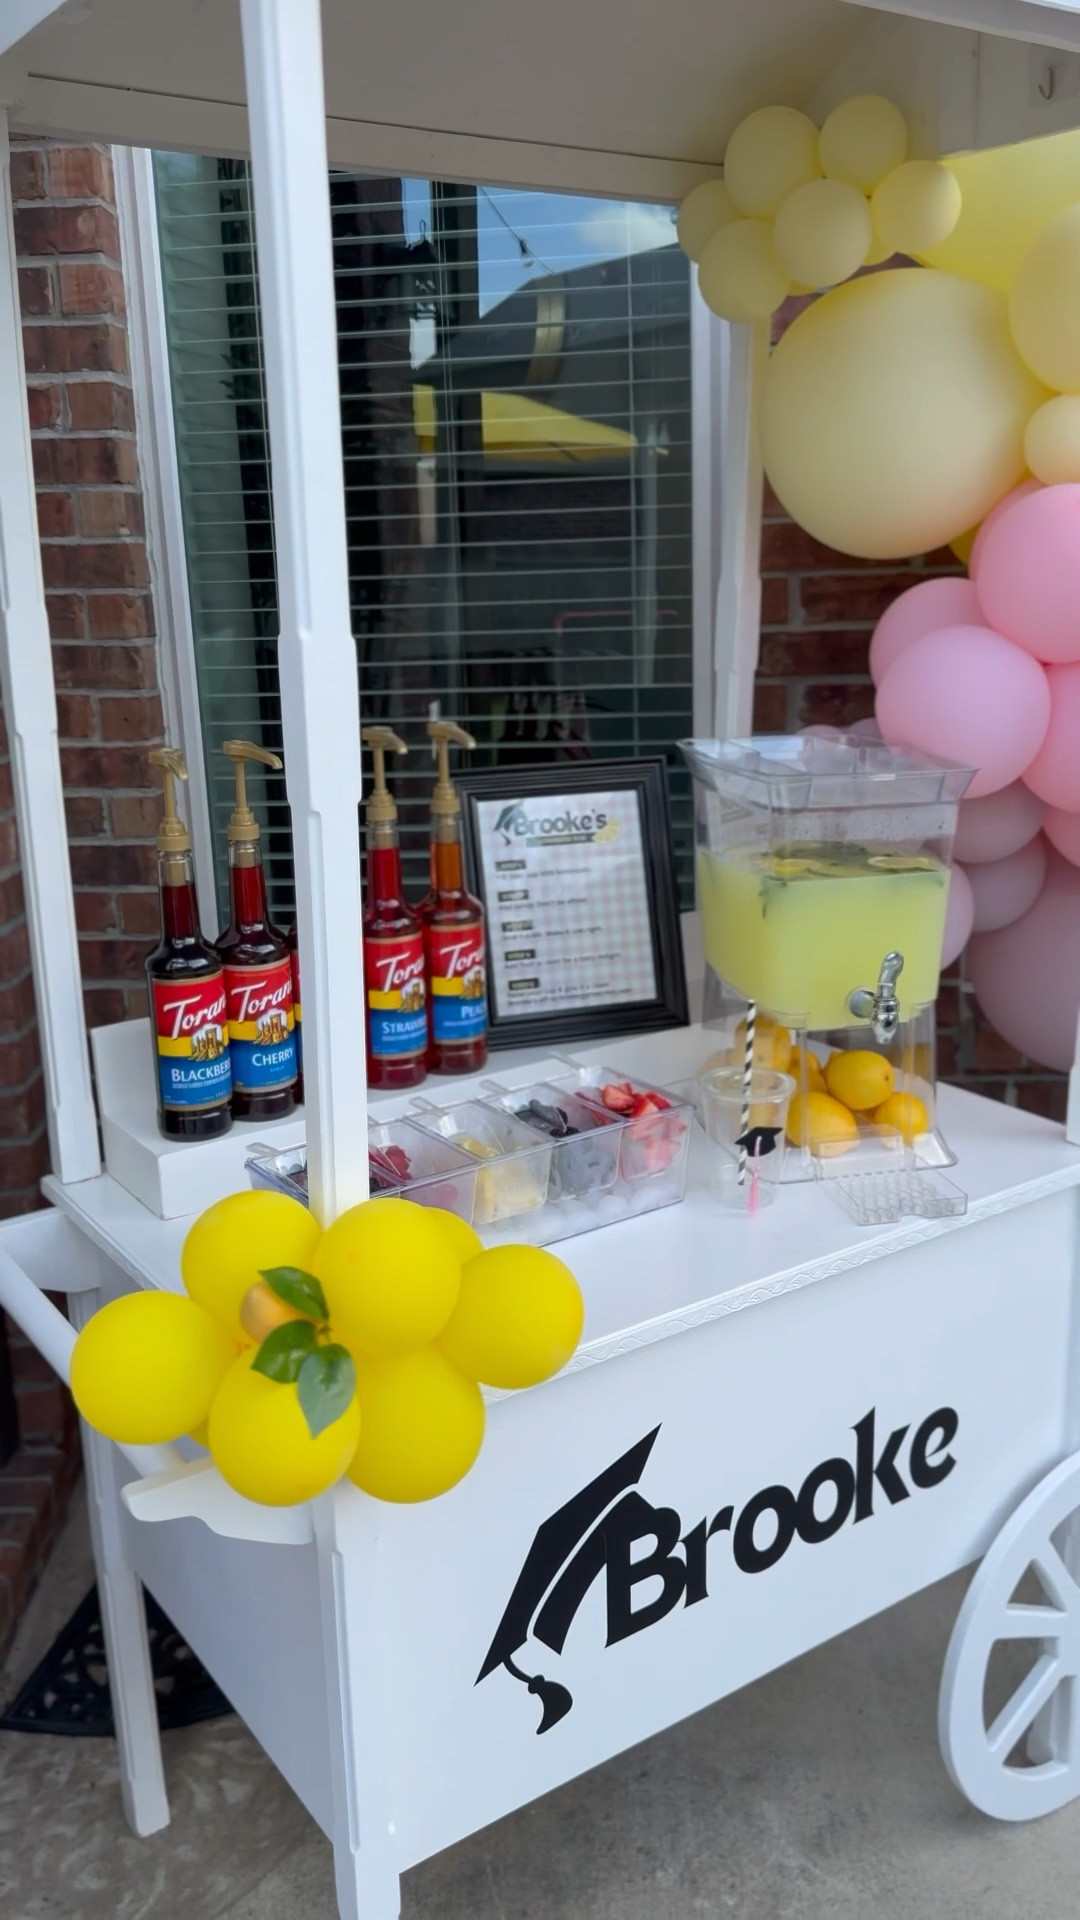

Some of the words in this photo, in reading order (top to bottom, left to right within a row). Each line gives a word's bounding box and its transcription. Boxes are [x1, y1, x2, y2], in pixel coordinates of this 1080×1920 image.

[514, 808, 607, 836] Brooke's
[252, 1047, 293, 1067] CHERRY
[605, 1405, 959, 1648] Brooke
